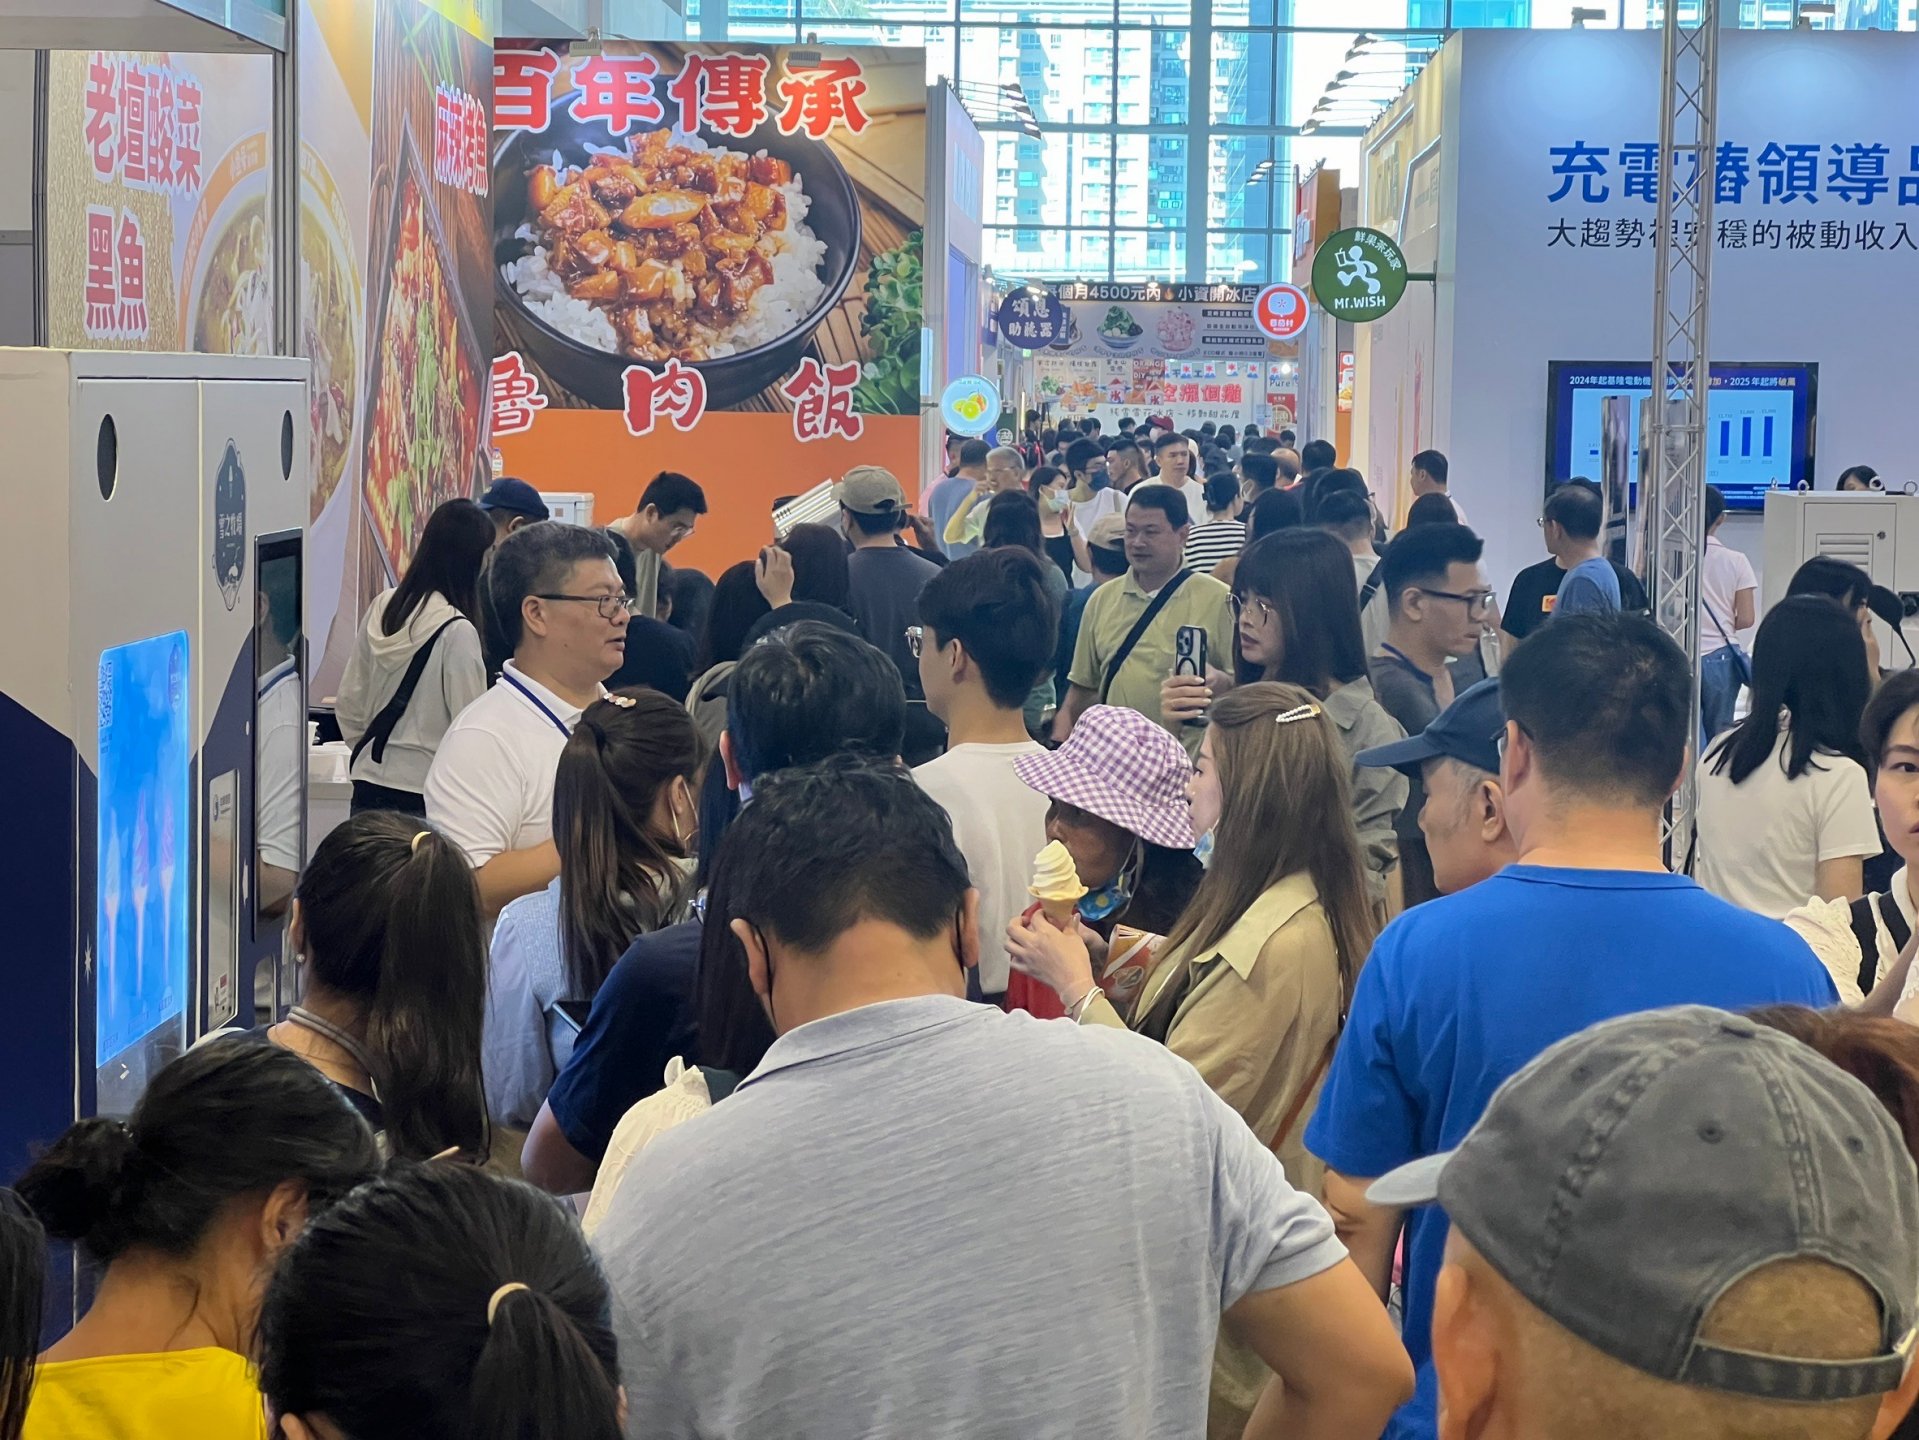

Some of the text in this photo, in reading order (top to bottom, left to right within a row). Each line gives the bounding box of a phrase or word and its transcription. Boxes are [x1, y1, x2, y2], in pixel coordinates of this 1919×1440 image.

[86, 53, 201, 196] 老壇酸菜
[494, 47, 873, 139] 百年傳承
[435, 82, 488, 197] 麻辣烤魚
[85, 207, 149, 336] 黑魚
[1354, 231, 1402, 271] 鮮果茶玩家
[1334, 295, 1386, 309] Mr.WISH
[493, 351, 863, 442] 魯肉飯
